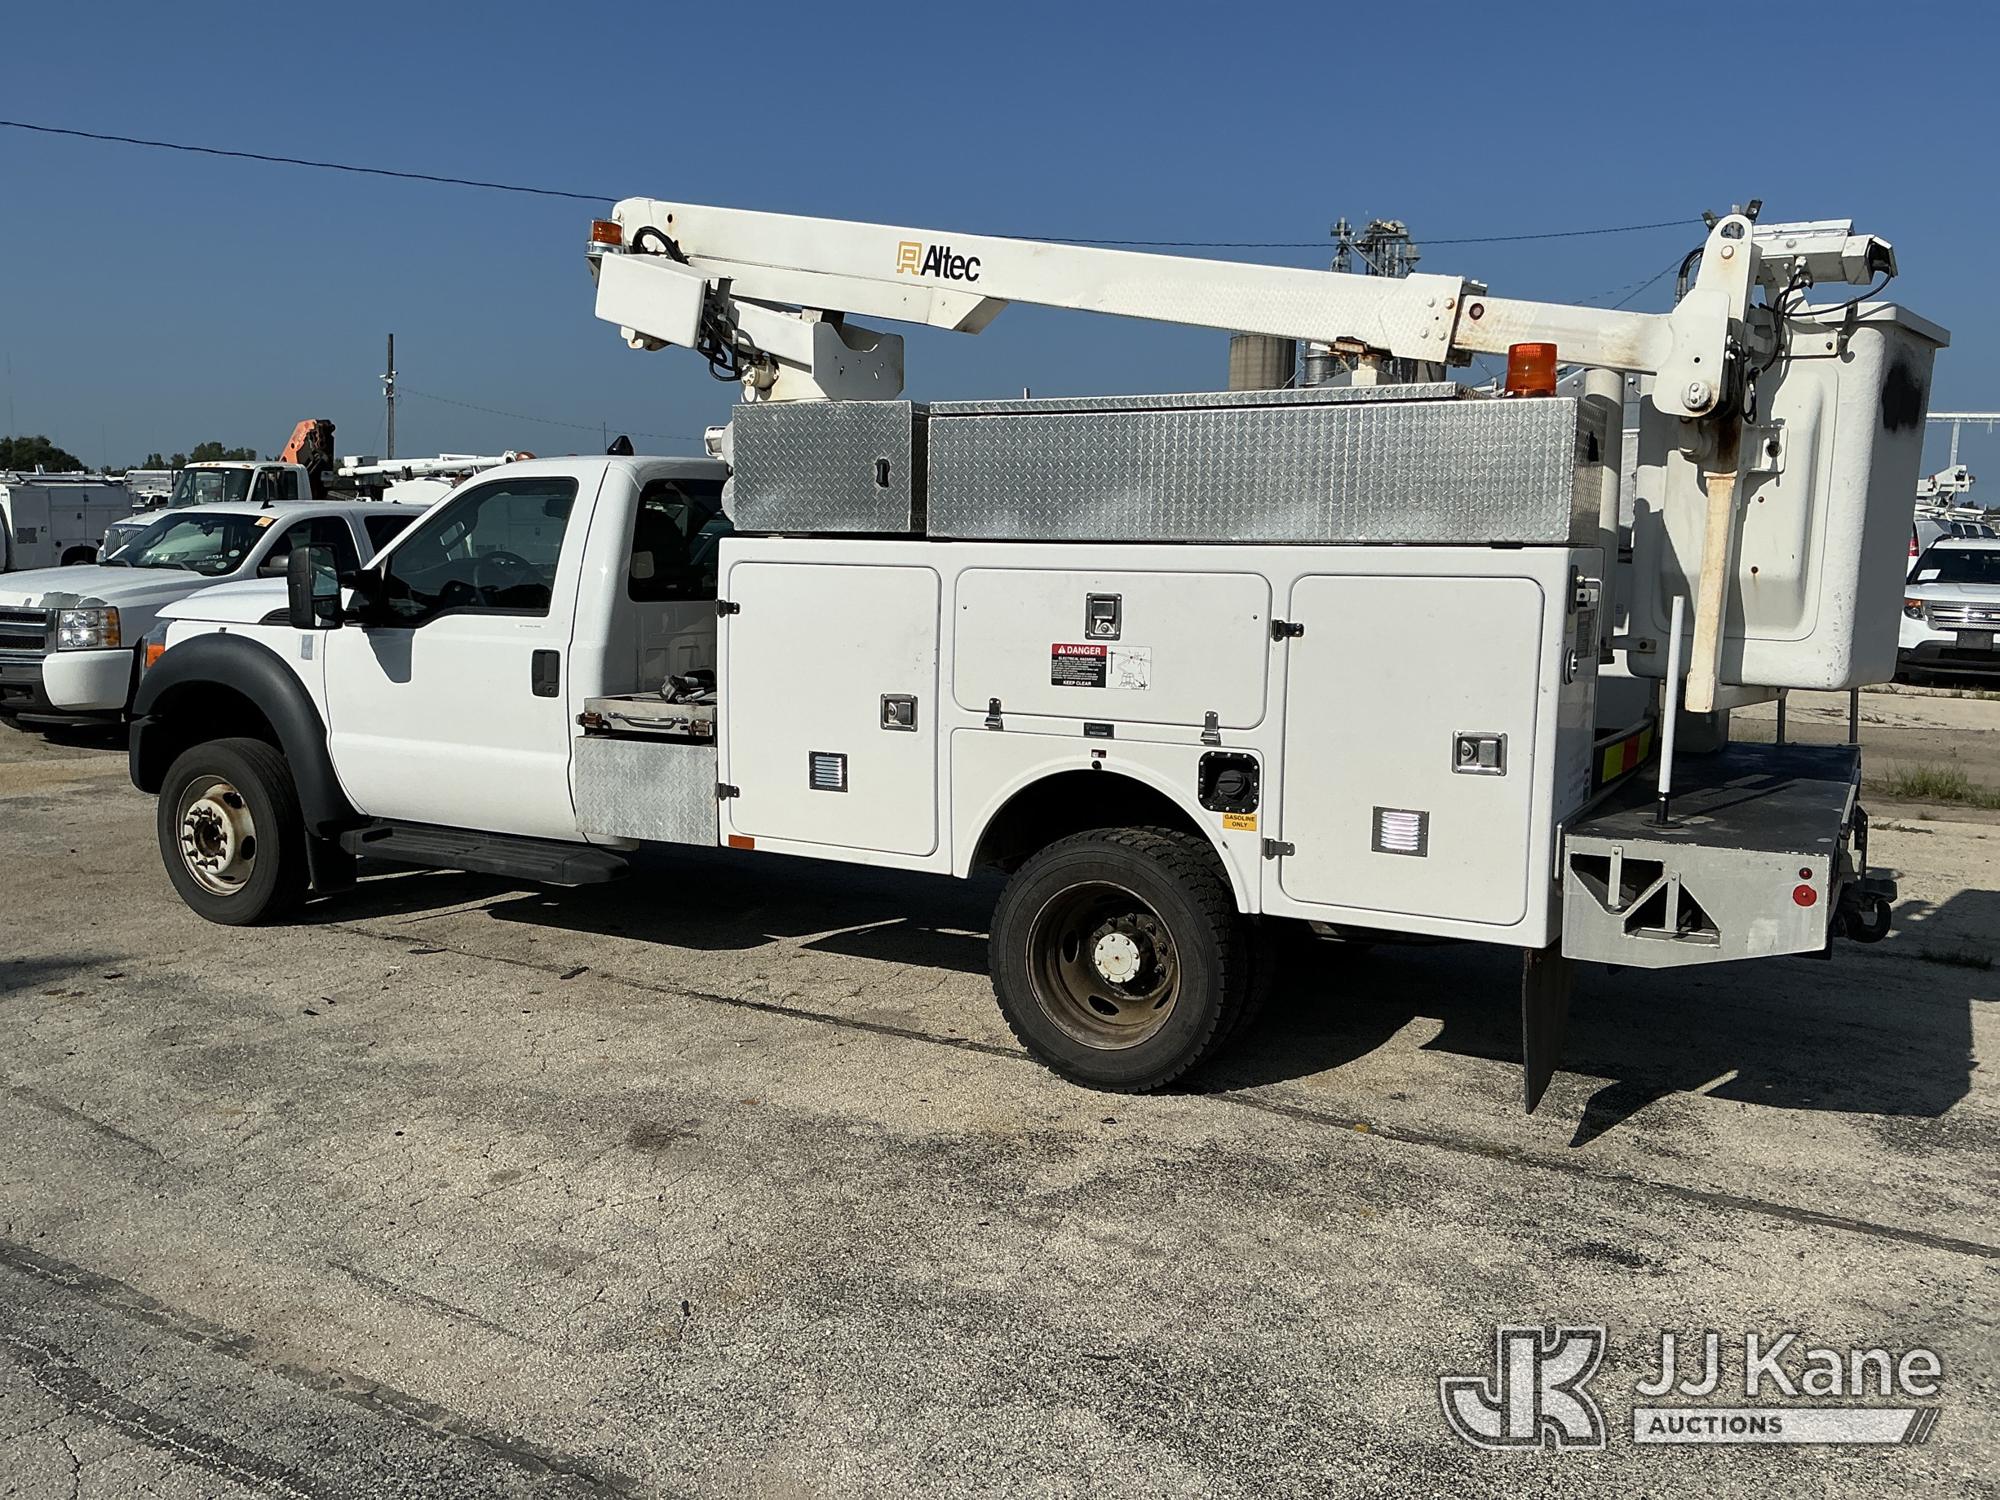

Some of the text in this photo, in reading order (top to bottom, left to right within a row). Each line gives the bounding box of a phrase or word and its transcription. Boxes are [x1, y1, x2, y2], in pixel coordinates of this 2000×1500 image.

[920, 244, 981, 282] Altec
[1067, 646, 1101, 655] DANGER
[1224, 814, 1255, 822] GASOLINE
